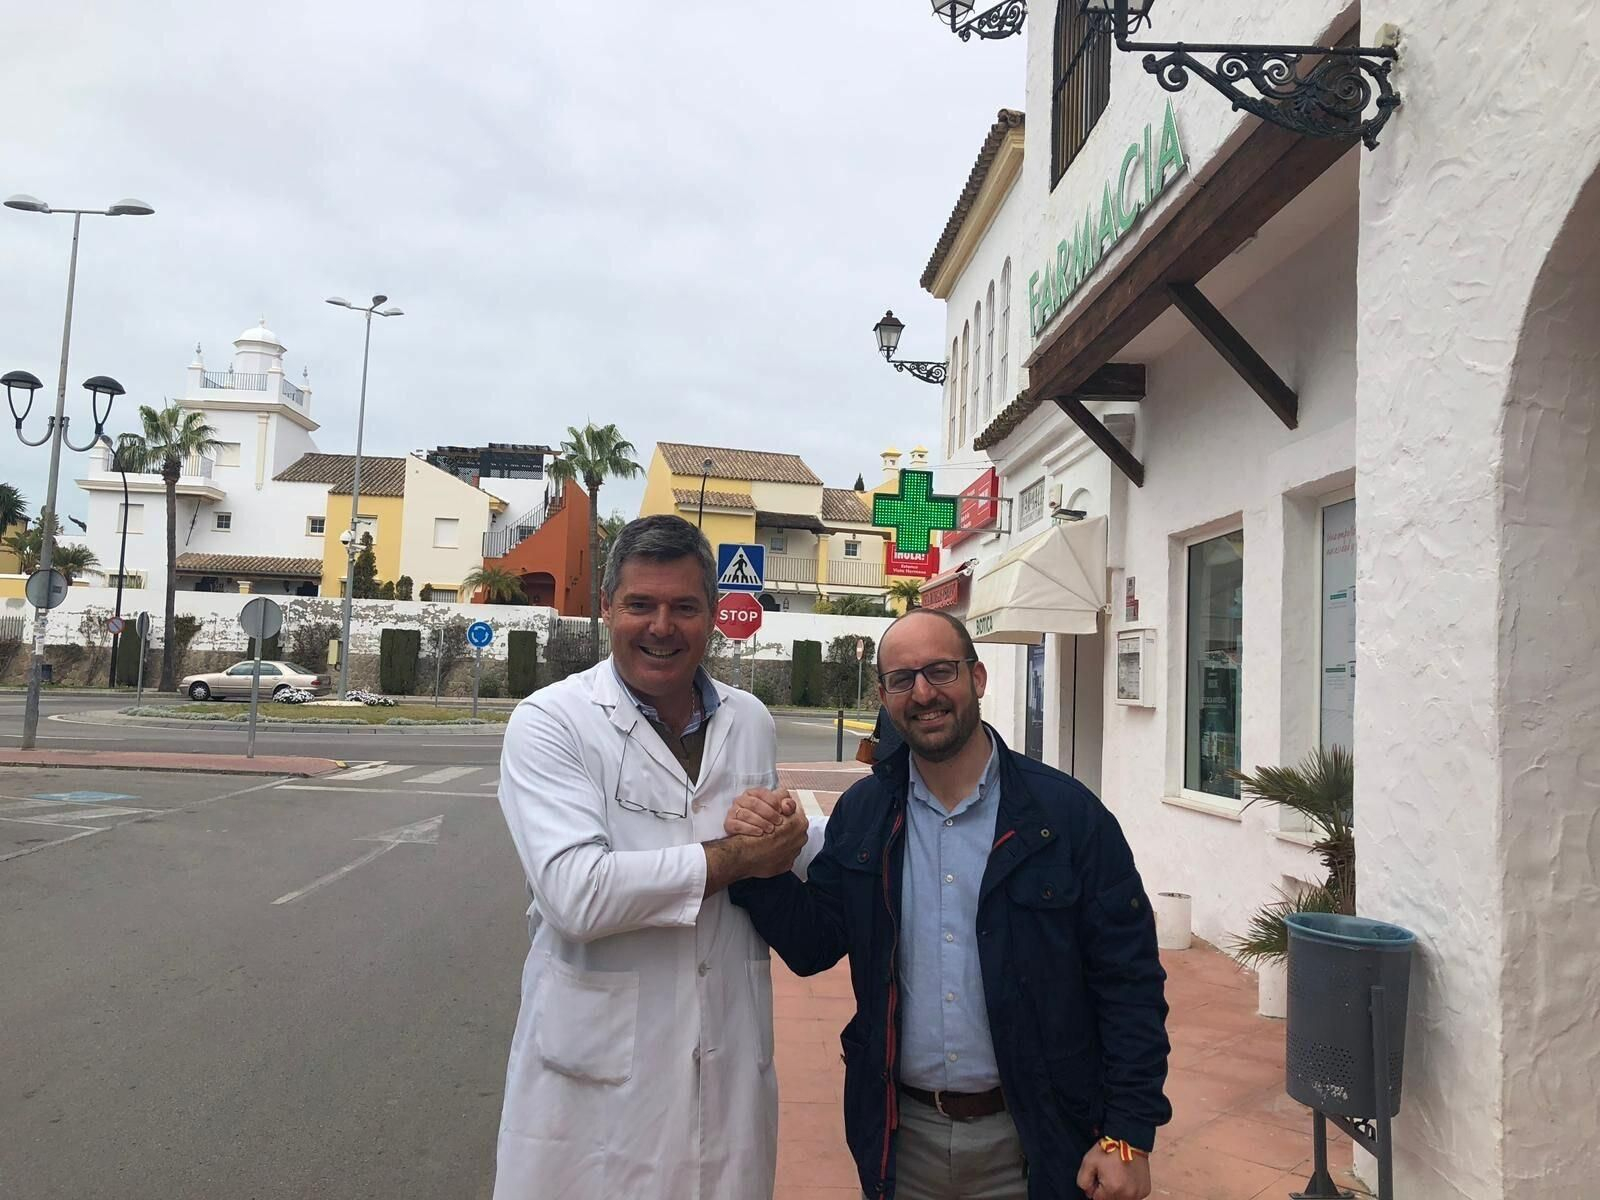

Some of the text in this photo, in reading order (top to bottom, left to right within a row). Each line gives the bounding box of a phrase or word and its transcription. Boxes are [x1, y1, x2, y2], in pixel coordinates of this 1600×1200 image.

[1028, 96, 1187, 336] FARMACIA
[719, 608, 758, 623] STOP
[976, 615, 993, 635] BOTICA
